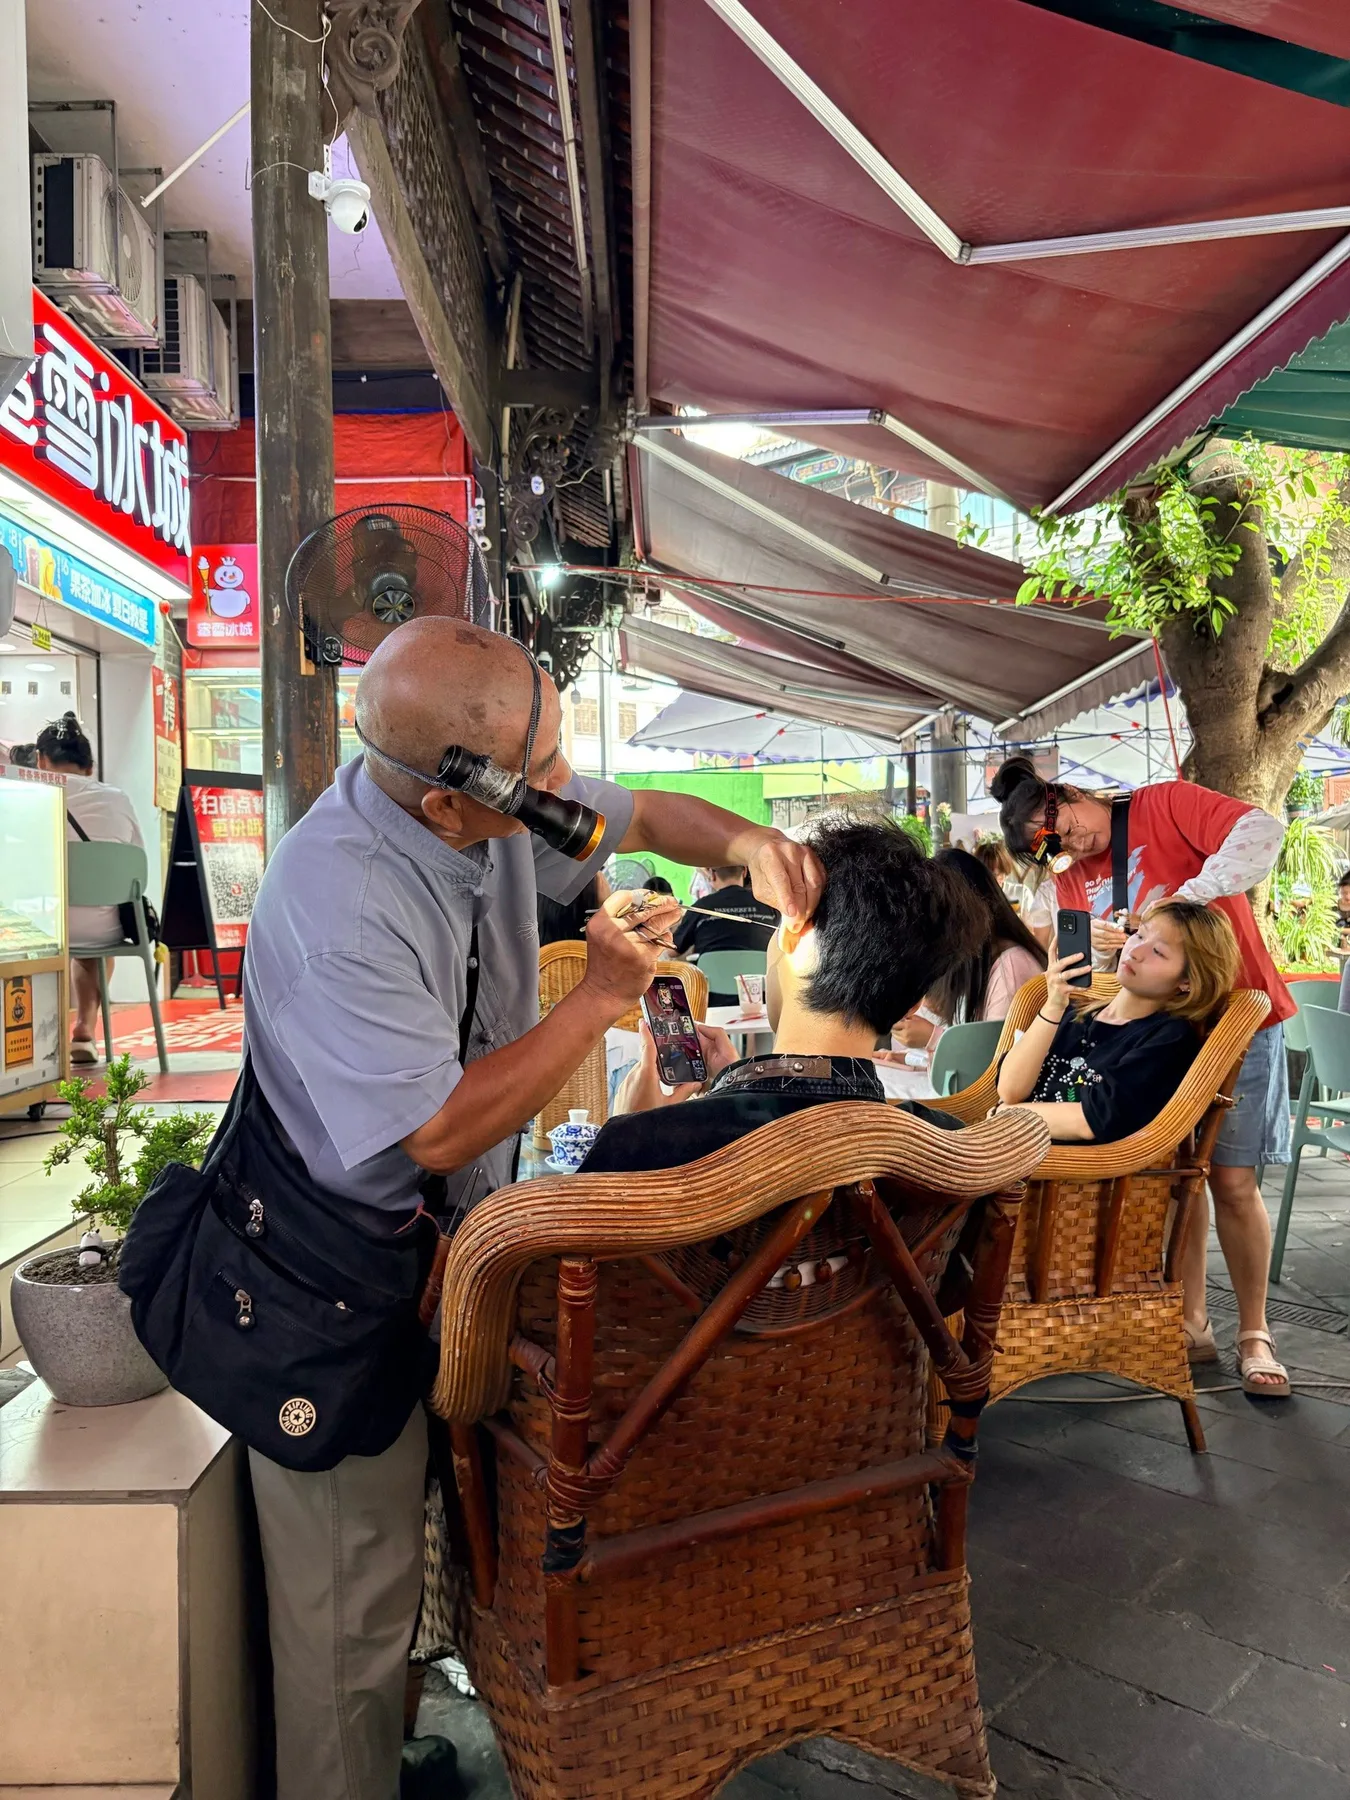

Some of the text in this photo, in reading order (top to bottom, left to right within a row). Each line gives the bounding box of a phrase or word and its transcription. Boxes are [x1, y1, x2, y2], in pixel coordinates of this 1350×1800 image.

[70, 567, 112, 614] 果茶加冰
[111, 591, 149, 635] 夏日救星
[197, 622, 253, 637] 蜜雪冰城
[287, 1401, 313, 1418] KIPLING
[282, 1416, 308, 1433] KIPLING
